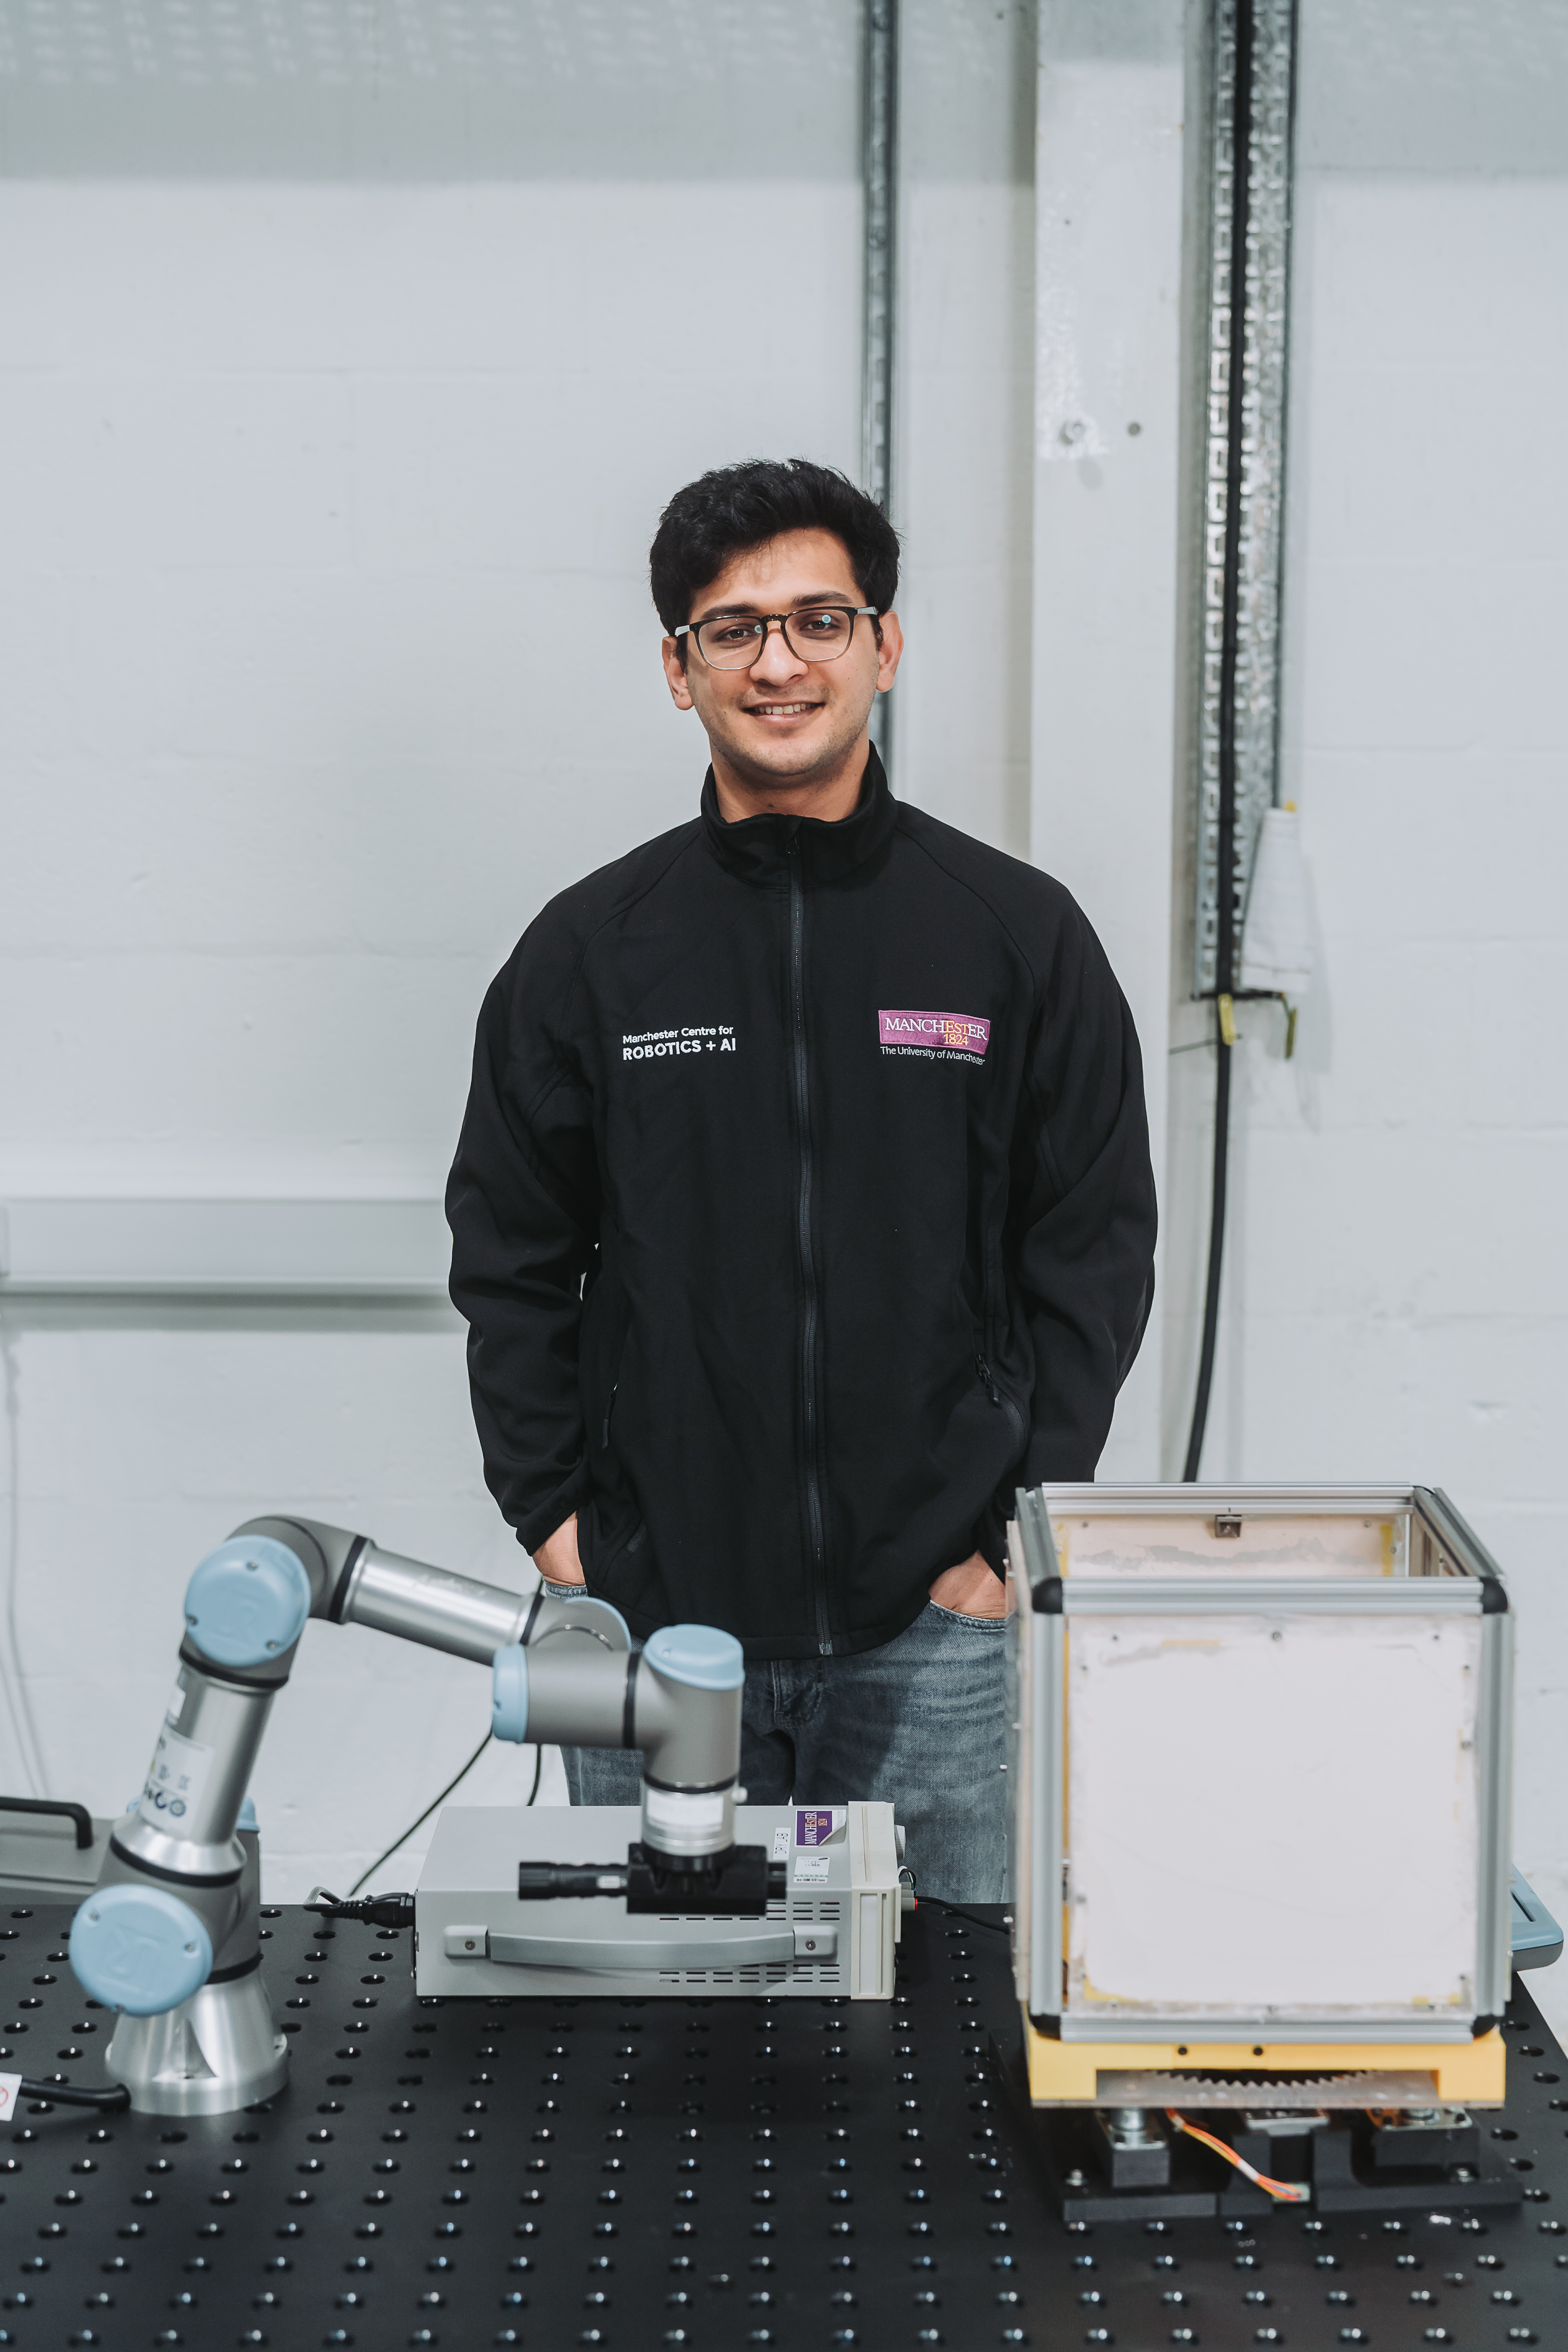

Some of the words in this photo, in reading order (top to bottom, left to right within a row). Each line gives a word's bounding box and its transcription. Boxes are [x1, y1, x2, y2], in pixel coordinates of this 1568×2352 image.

[623, 1030, 678, 1044] Manchester
[681, 1027, 716, 1037] Centre
[718, 1025, 733, 1035] for
[885, 1017, 987, 1041] MANCHESTER
[623, 1039, 701, 1060] ROBOTICS
[706, 1041, 716, 1051] +
[720, 1038, 736, 1051] AI
[943, 1033, 969, 1046] 1824
[880, 1046, 896, 1055] The
[897, 1046, 935, 1059] University
[937, 1050, 946, 1058] of
[946, 1051, 985, 1065] Manchester
[776, 1833, 788, 1842] LAB
[805, 1812, 817, 1844] MANCHESTER
[775, 1843, 787, 1854] DRY
